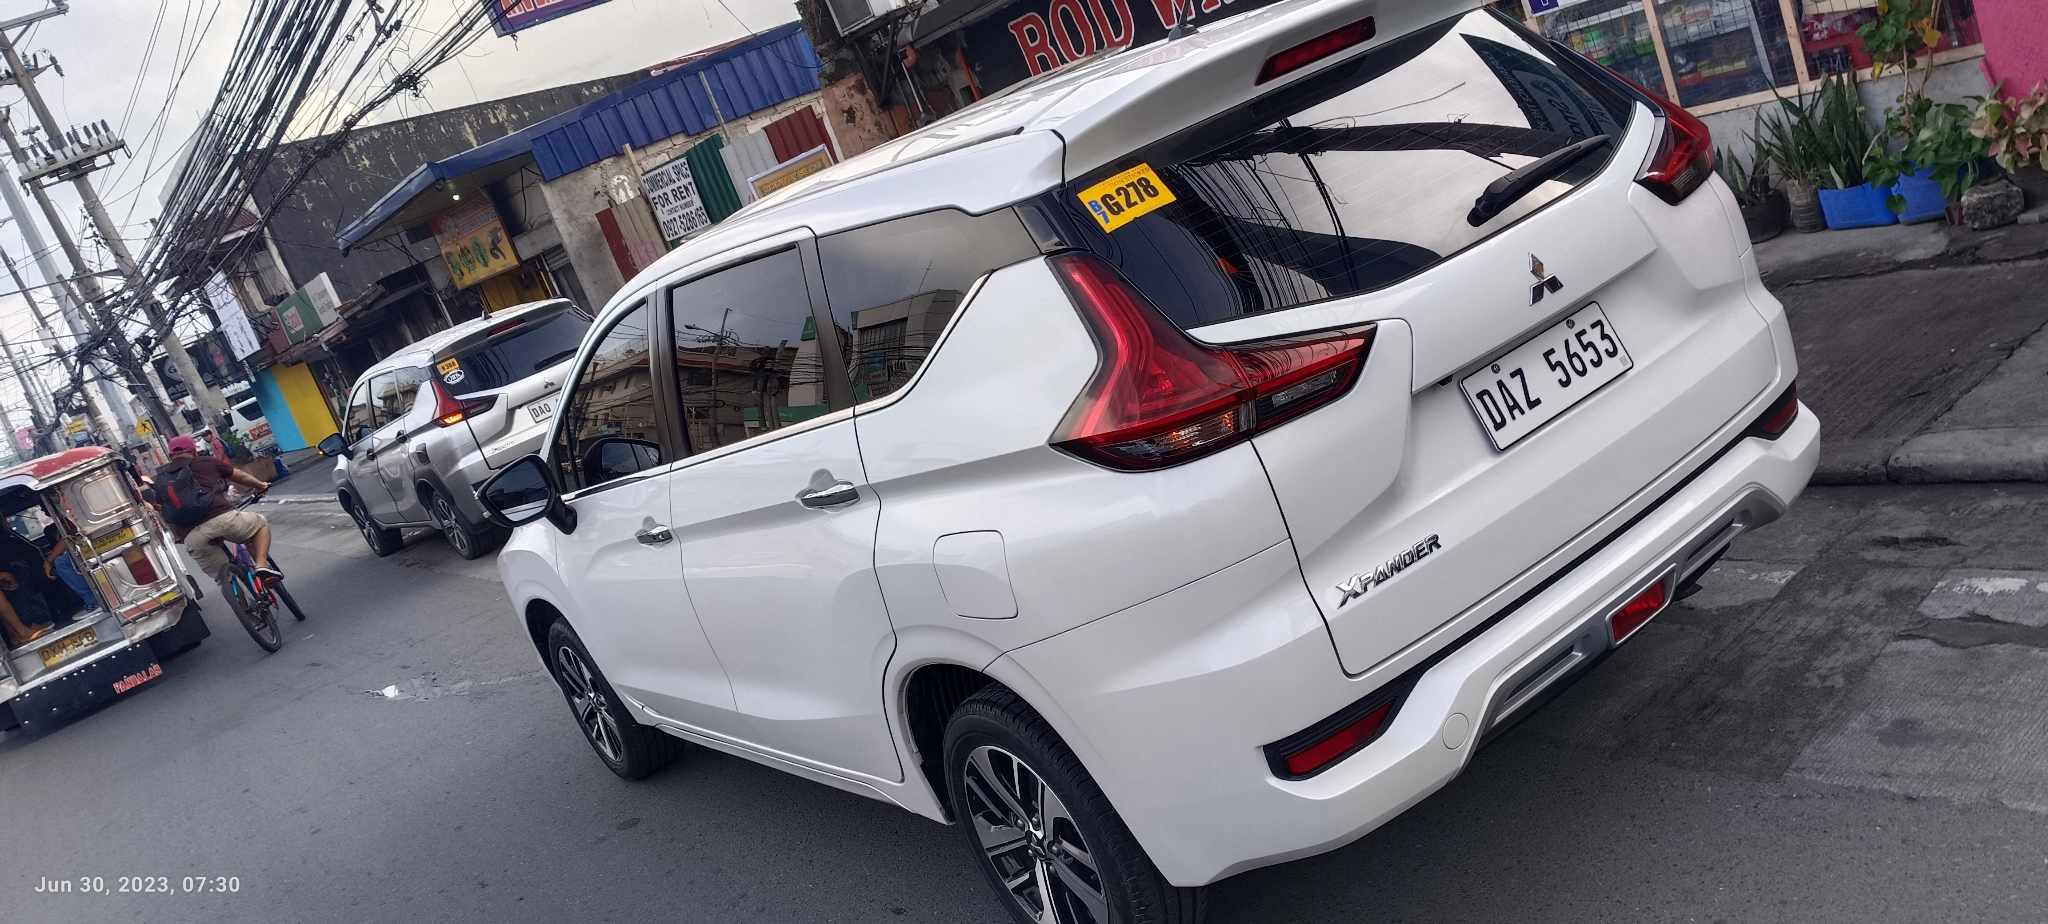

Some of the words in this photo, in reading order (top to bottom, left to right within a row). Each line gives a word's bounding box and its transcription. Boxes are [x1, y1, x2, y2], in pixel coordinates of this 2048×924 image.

[652, 191, 673, 211] FOR
[671, 182, 696, 203] RENT
[1100, 176, 1160, 217] G278
[1476, 367, 1542, 432] DAZ
[1542, 319, 1619, 388] 5653
[1335, 533, 1442, 610] XPANDER
